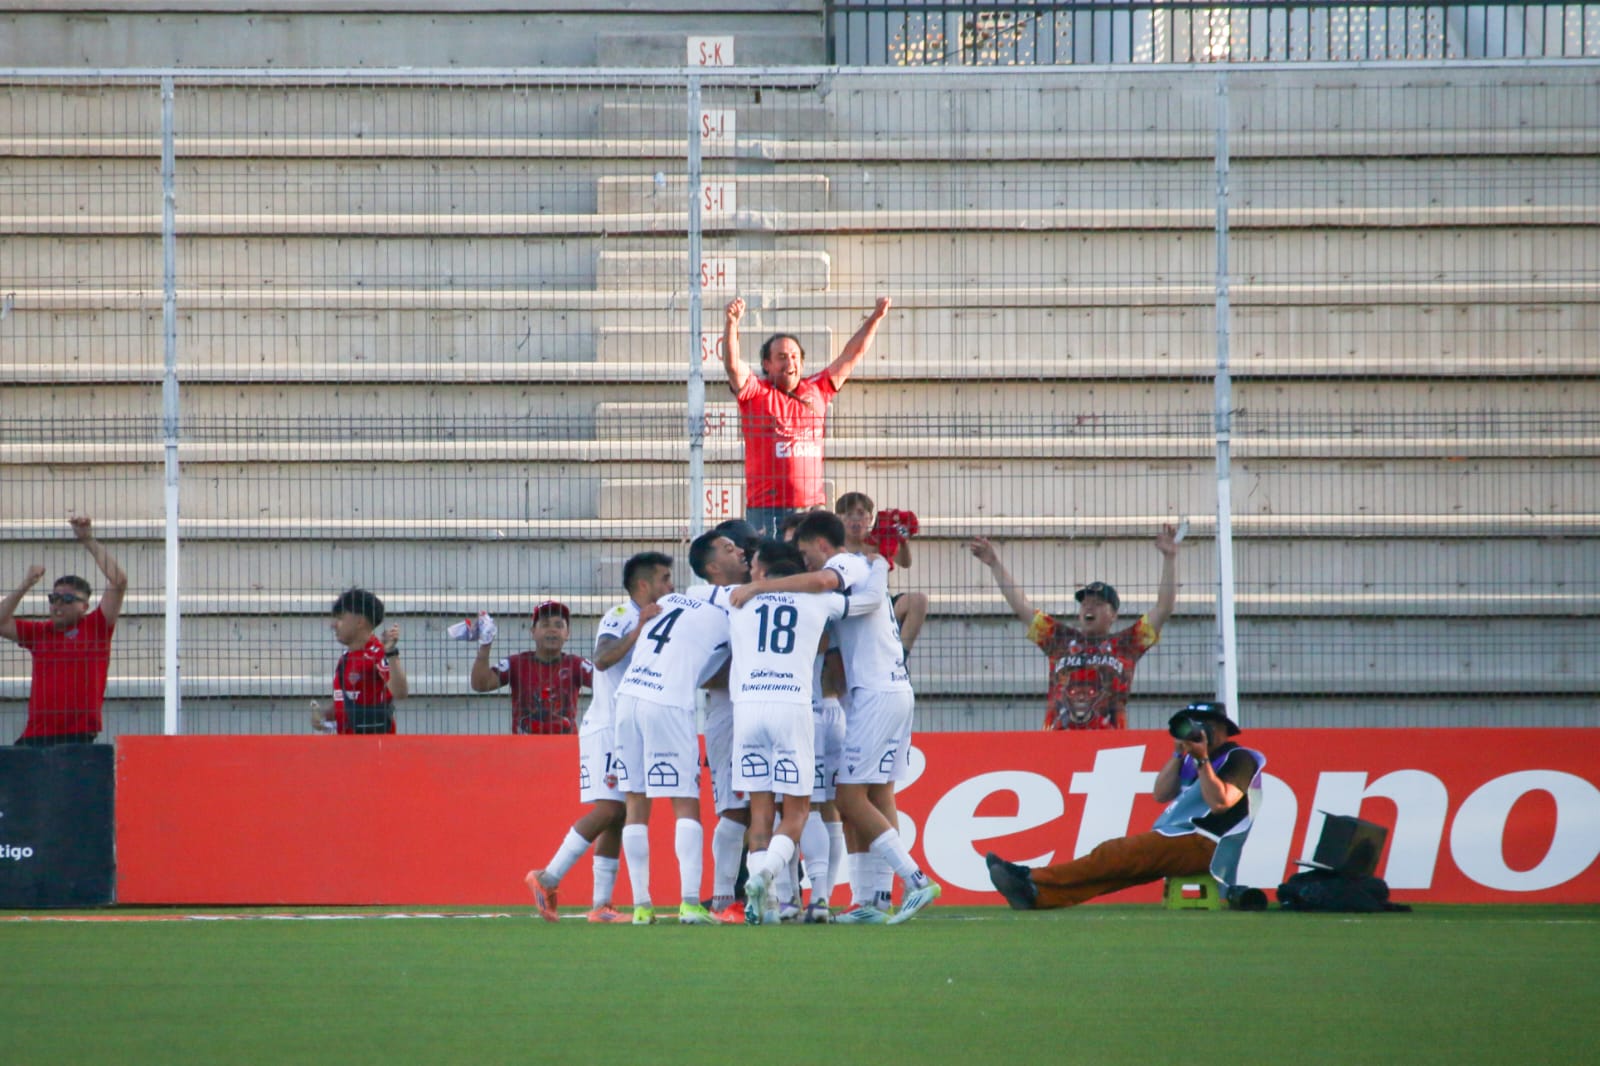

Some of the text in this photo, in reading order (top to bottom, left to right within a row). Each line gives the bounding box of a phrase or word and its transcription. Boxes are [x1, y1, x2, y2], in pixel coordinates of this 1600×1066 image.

[699, 41, 723, 66] S-K
[702, 114, 725, 138] S-J
[704, 186, 724, 211] S-I
[701, 262, 726, 287] S-H
[703, 412, 726, 436] S-F
[705, 489, 729, 514] S-E
[646, 607, 685, 654] 4
[755, 603, 799, 655] 18
[0, 844, 34, 861] tigo
